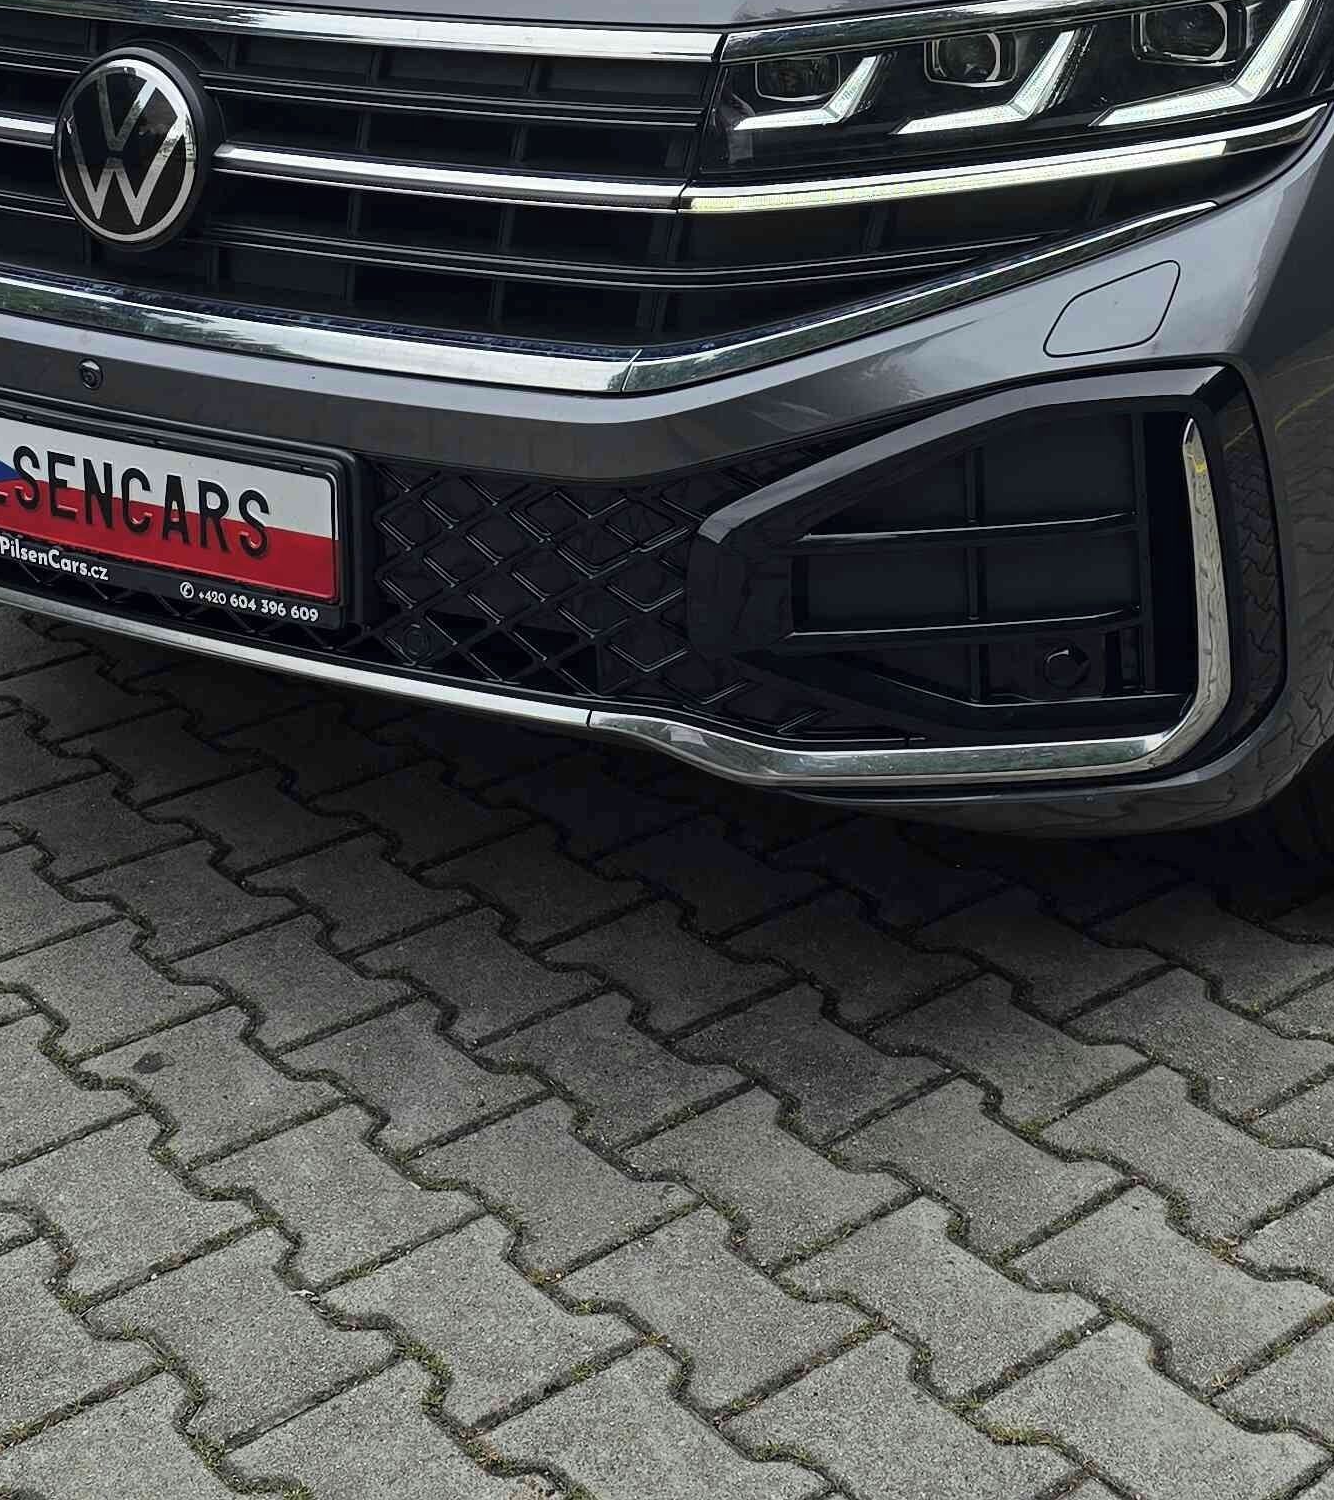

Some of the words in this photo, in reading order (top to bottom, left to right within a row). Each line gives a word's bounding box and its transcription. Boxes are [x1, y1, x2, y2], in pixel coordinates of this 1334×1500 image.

[60, 56, 197, 243] VW
[0, 534, 109, 581] PilsenCars.cz
[198, 590, 227, 605] +420
[229, 593, 257, 611] 604
[260, 599, 287, 617] 396
[290, 605, 319, 622] 609
